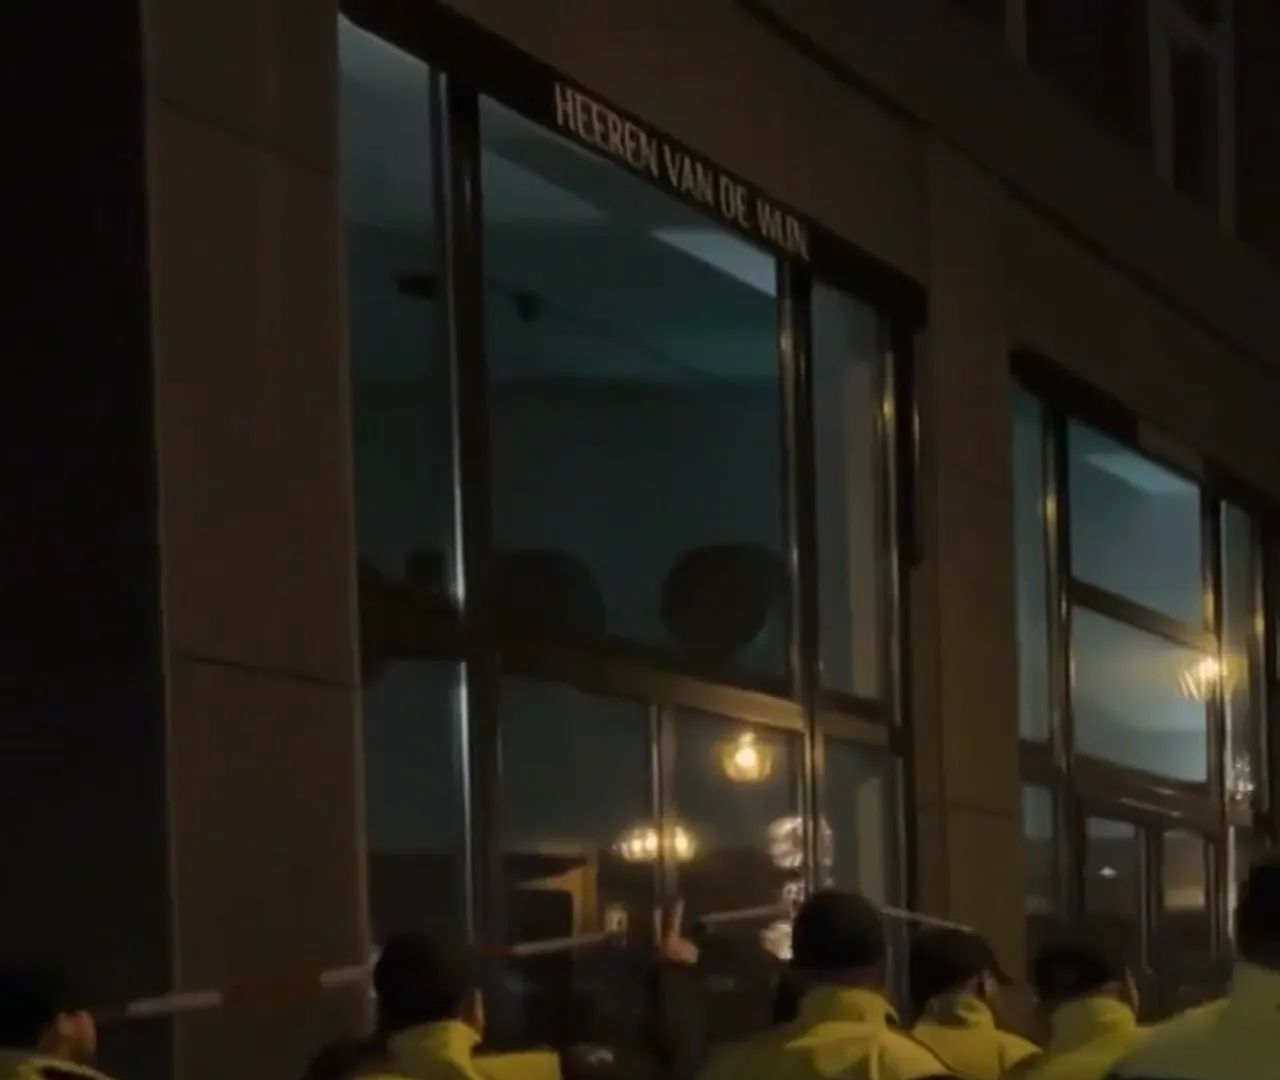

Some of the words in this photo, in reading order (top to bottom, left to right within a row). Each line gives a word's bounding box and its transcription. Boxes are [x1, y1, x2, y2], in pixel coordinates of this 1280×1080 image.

[553, 81, 659, 179] HEEREN
[663, 142, 714, 207] VAN
[717, 171, 750, 228] DE
